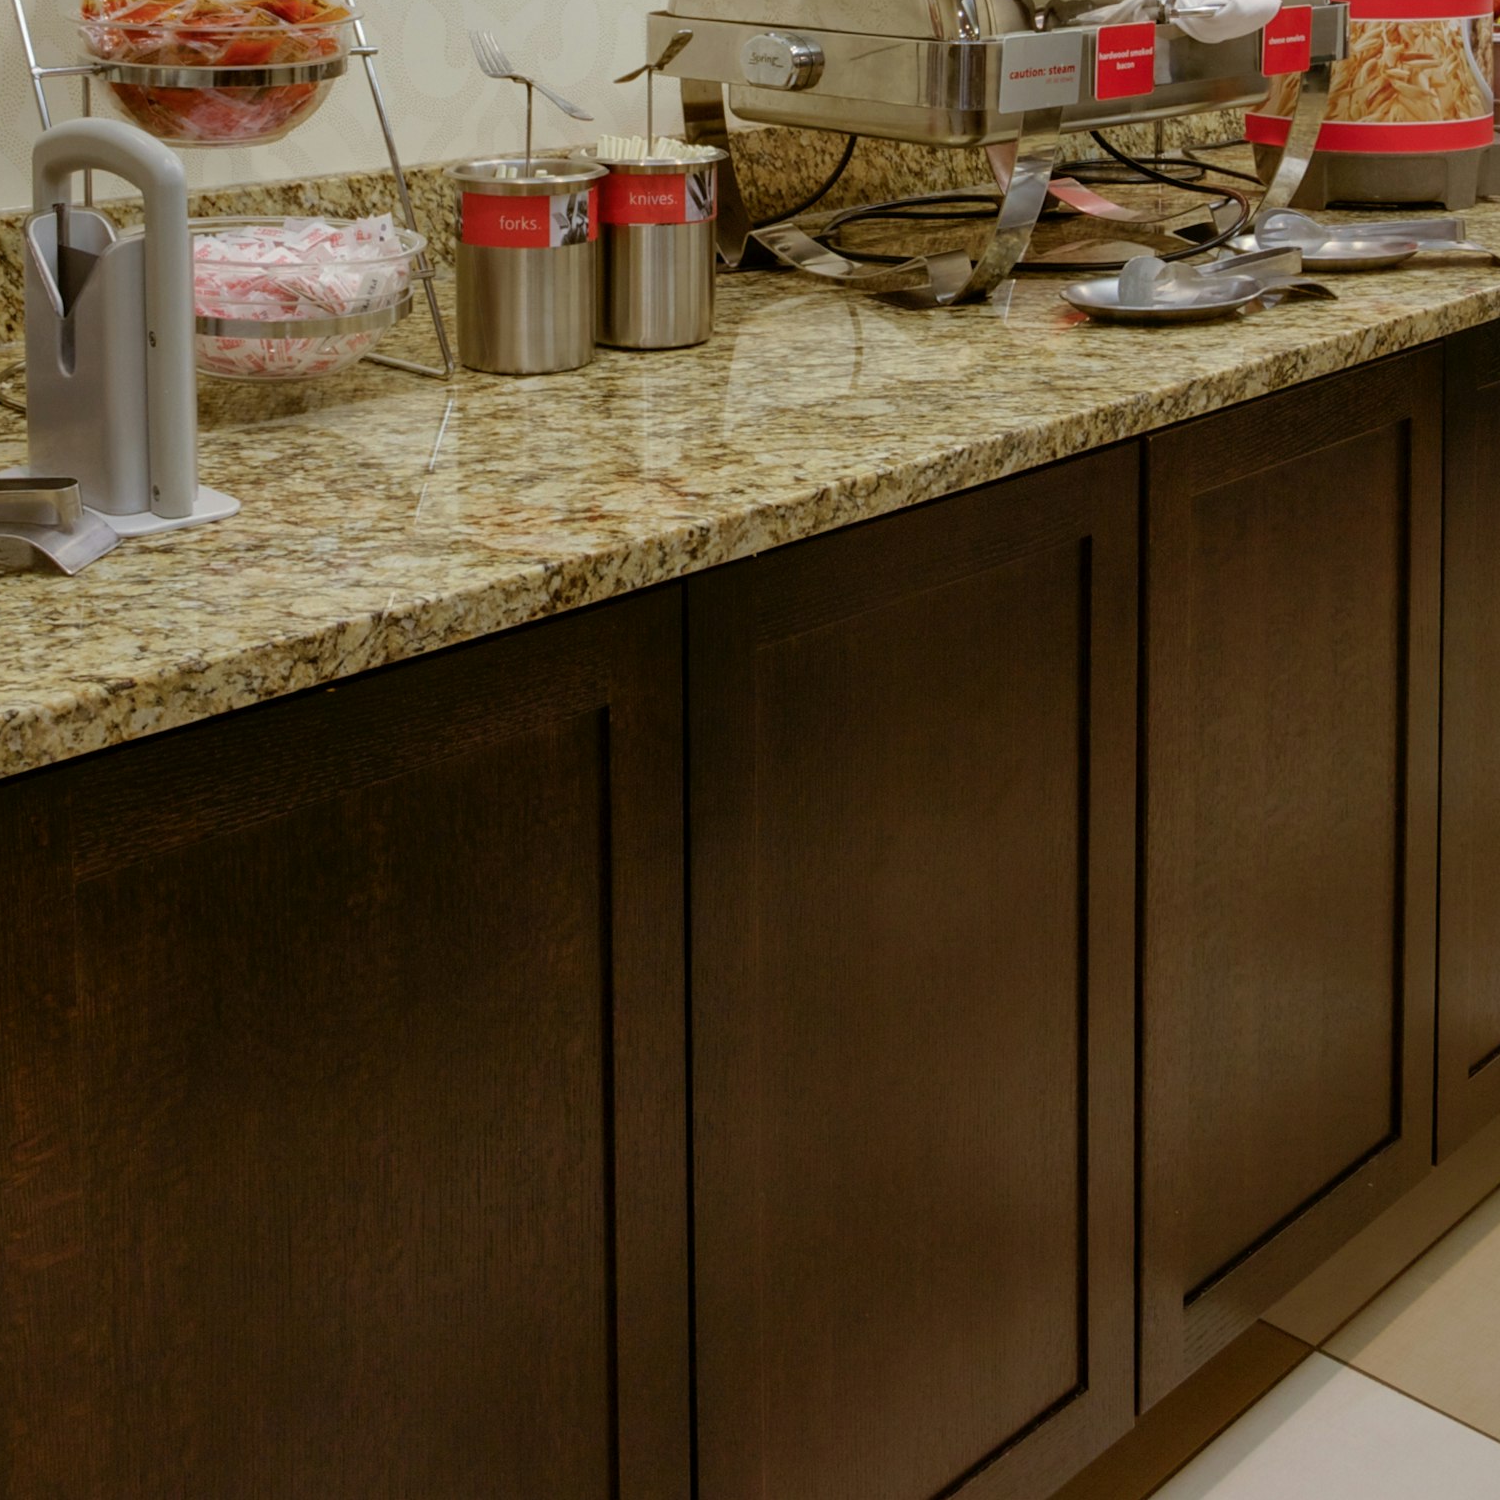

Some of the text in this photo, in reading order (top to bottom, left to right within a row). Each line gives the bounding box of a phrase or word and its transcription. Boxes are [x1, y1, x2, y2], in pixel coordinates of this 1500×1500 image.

[1098, 47, 1153, 61] hardwood smoked
[1009, 64, 1076, 80] caution: steam
[1116, 61, 1135, 70] bacon
[629, 191, 678, 206] knives.
[499, 215, 542, 231] forks.
